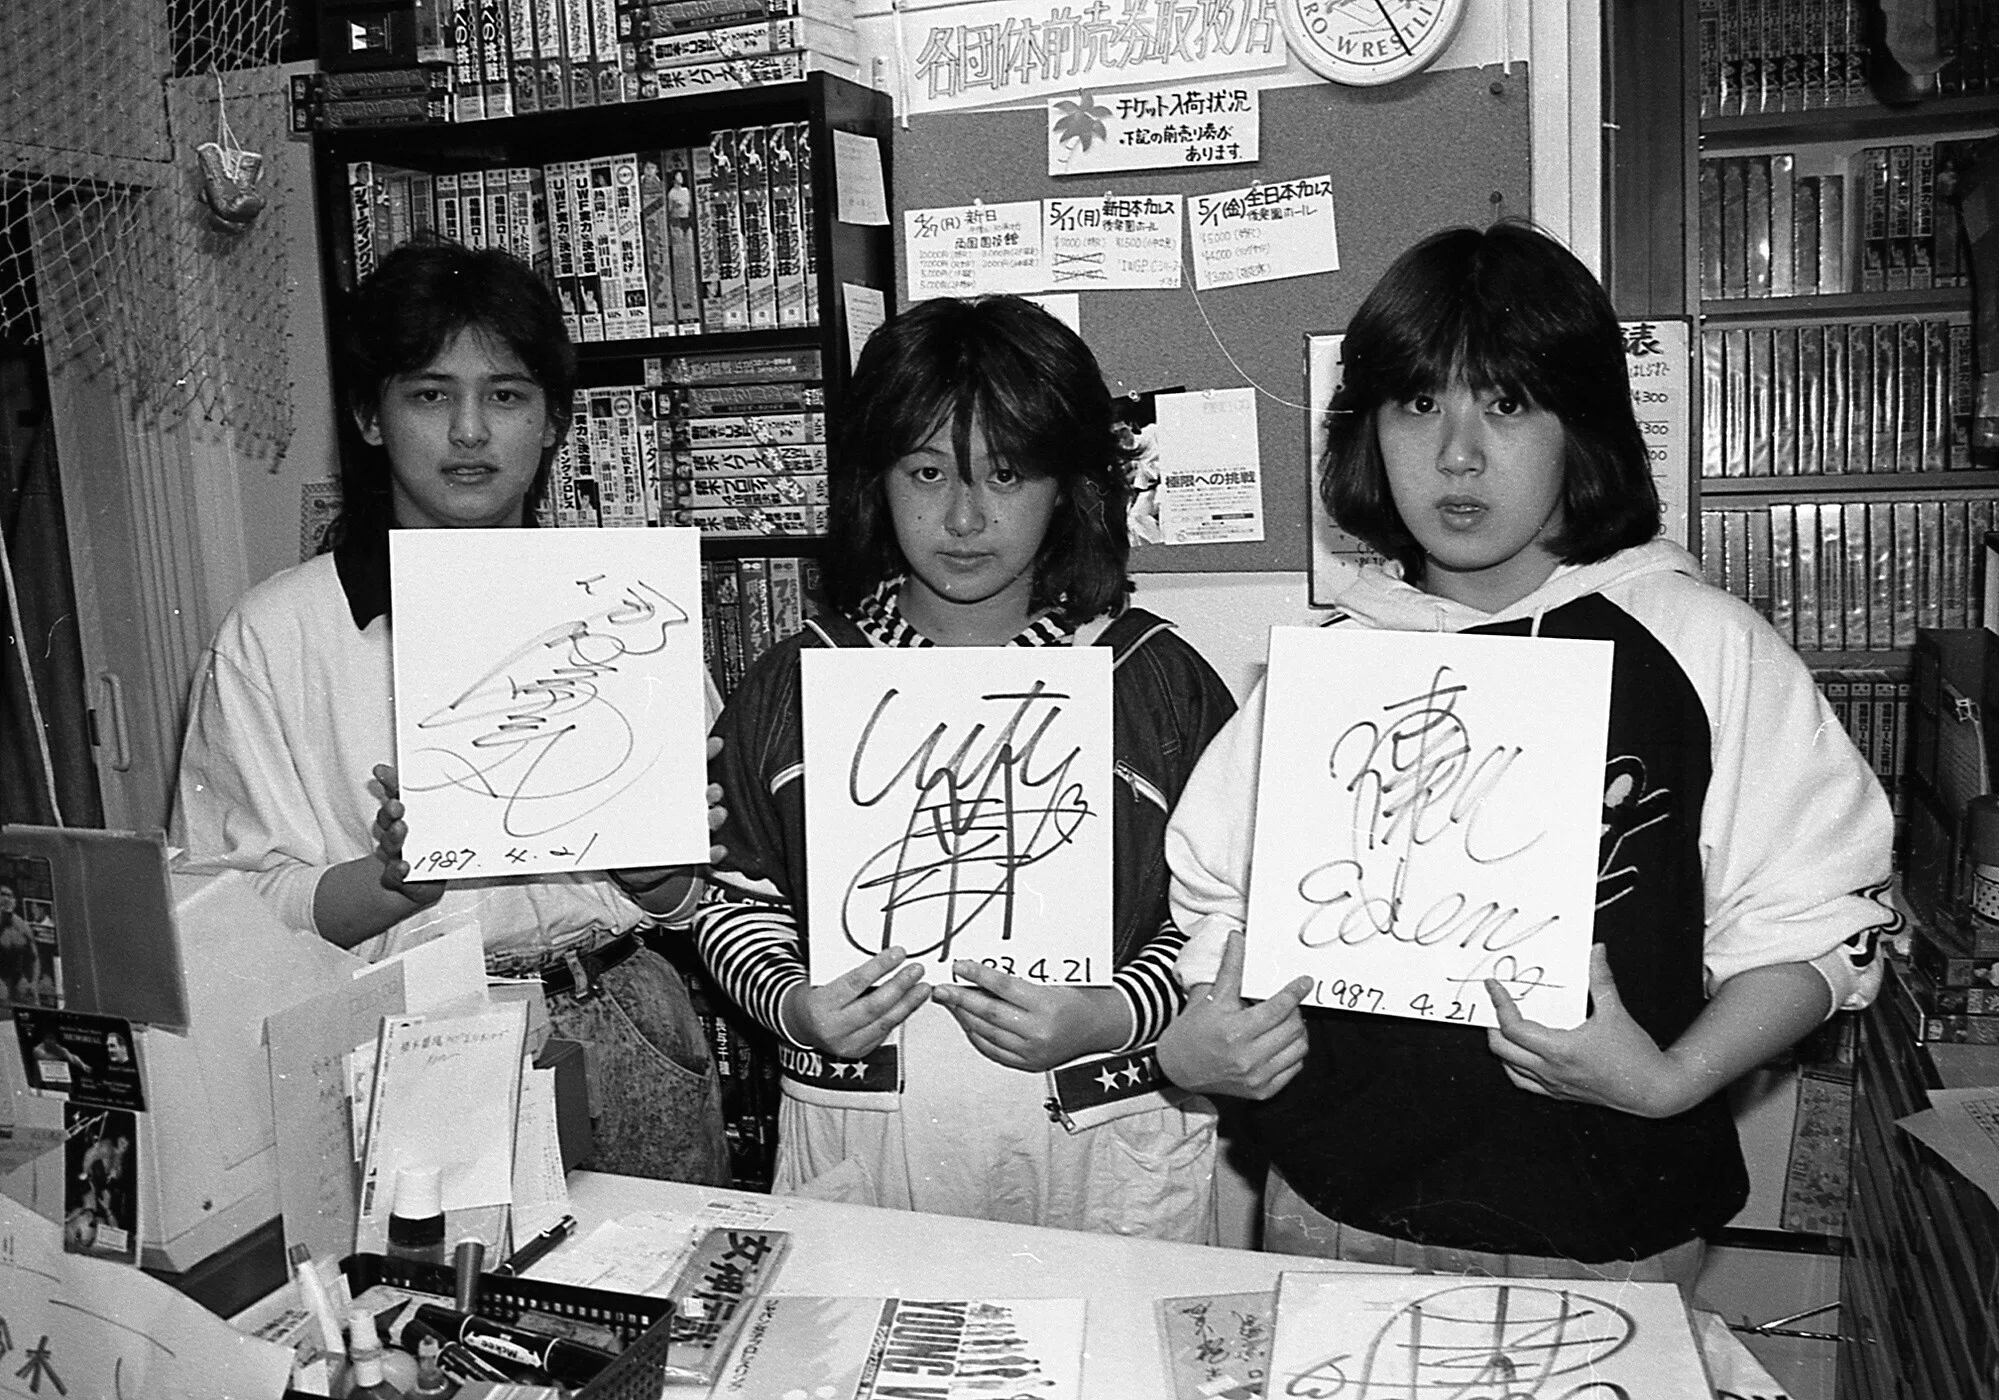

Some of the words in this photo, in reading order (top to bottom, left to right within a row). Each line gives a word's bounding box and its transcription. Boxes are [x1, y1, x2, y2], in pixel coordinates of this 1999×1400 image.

[1116, 89, 1252, 120] チケット入荷状況
[1244, 180, 1333, 207] 全日本プロレス
[1101, 197, 1176, 218] 新日本プロレス
[1639, 422, 1669, 435] 300
